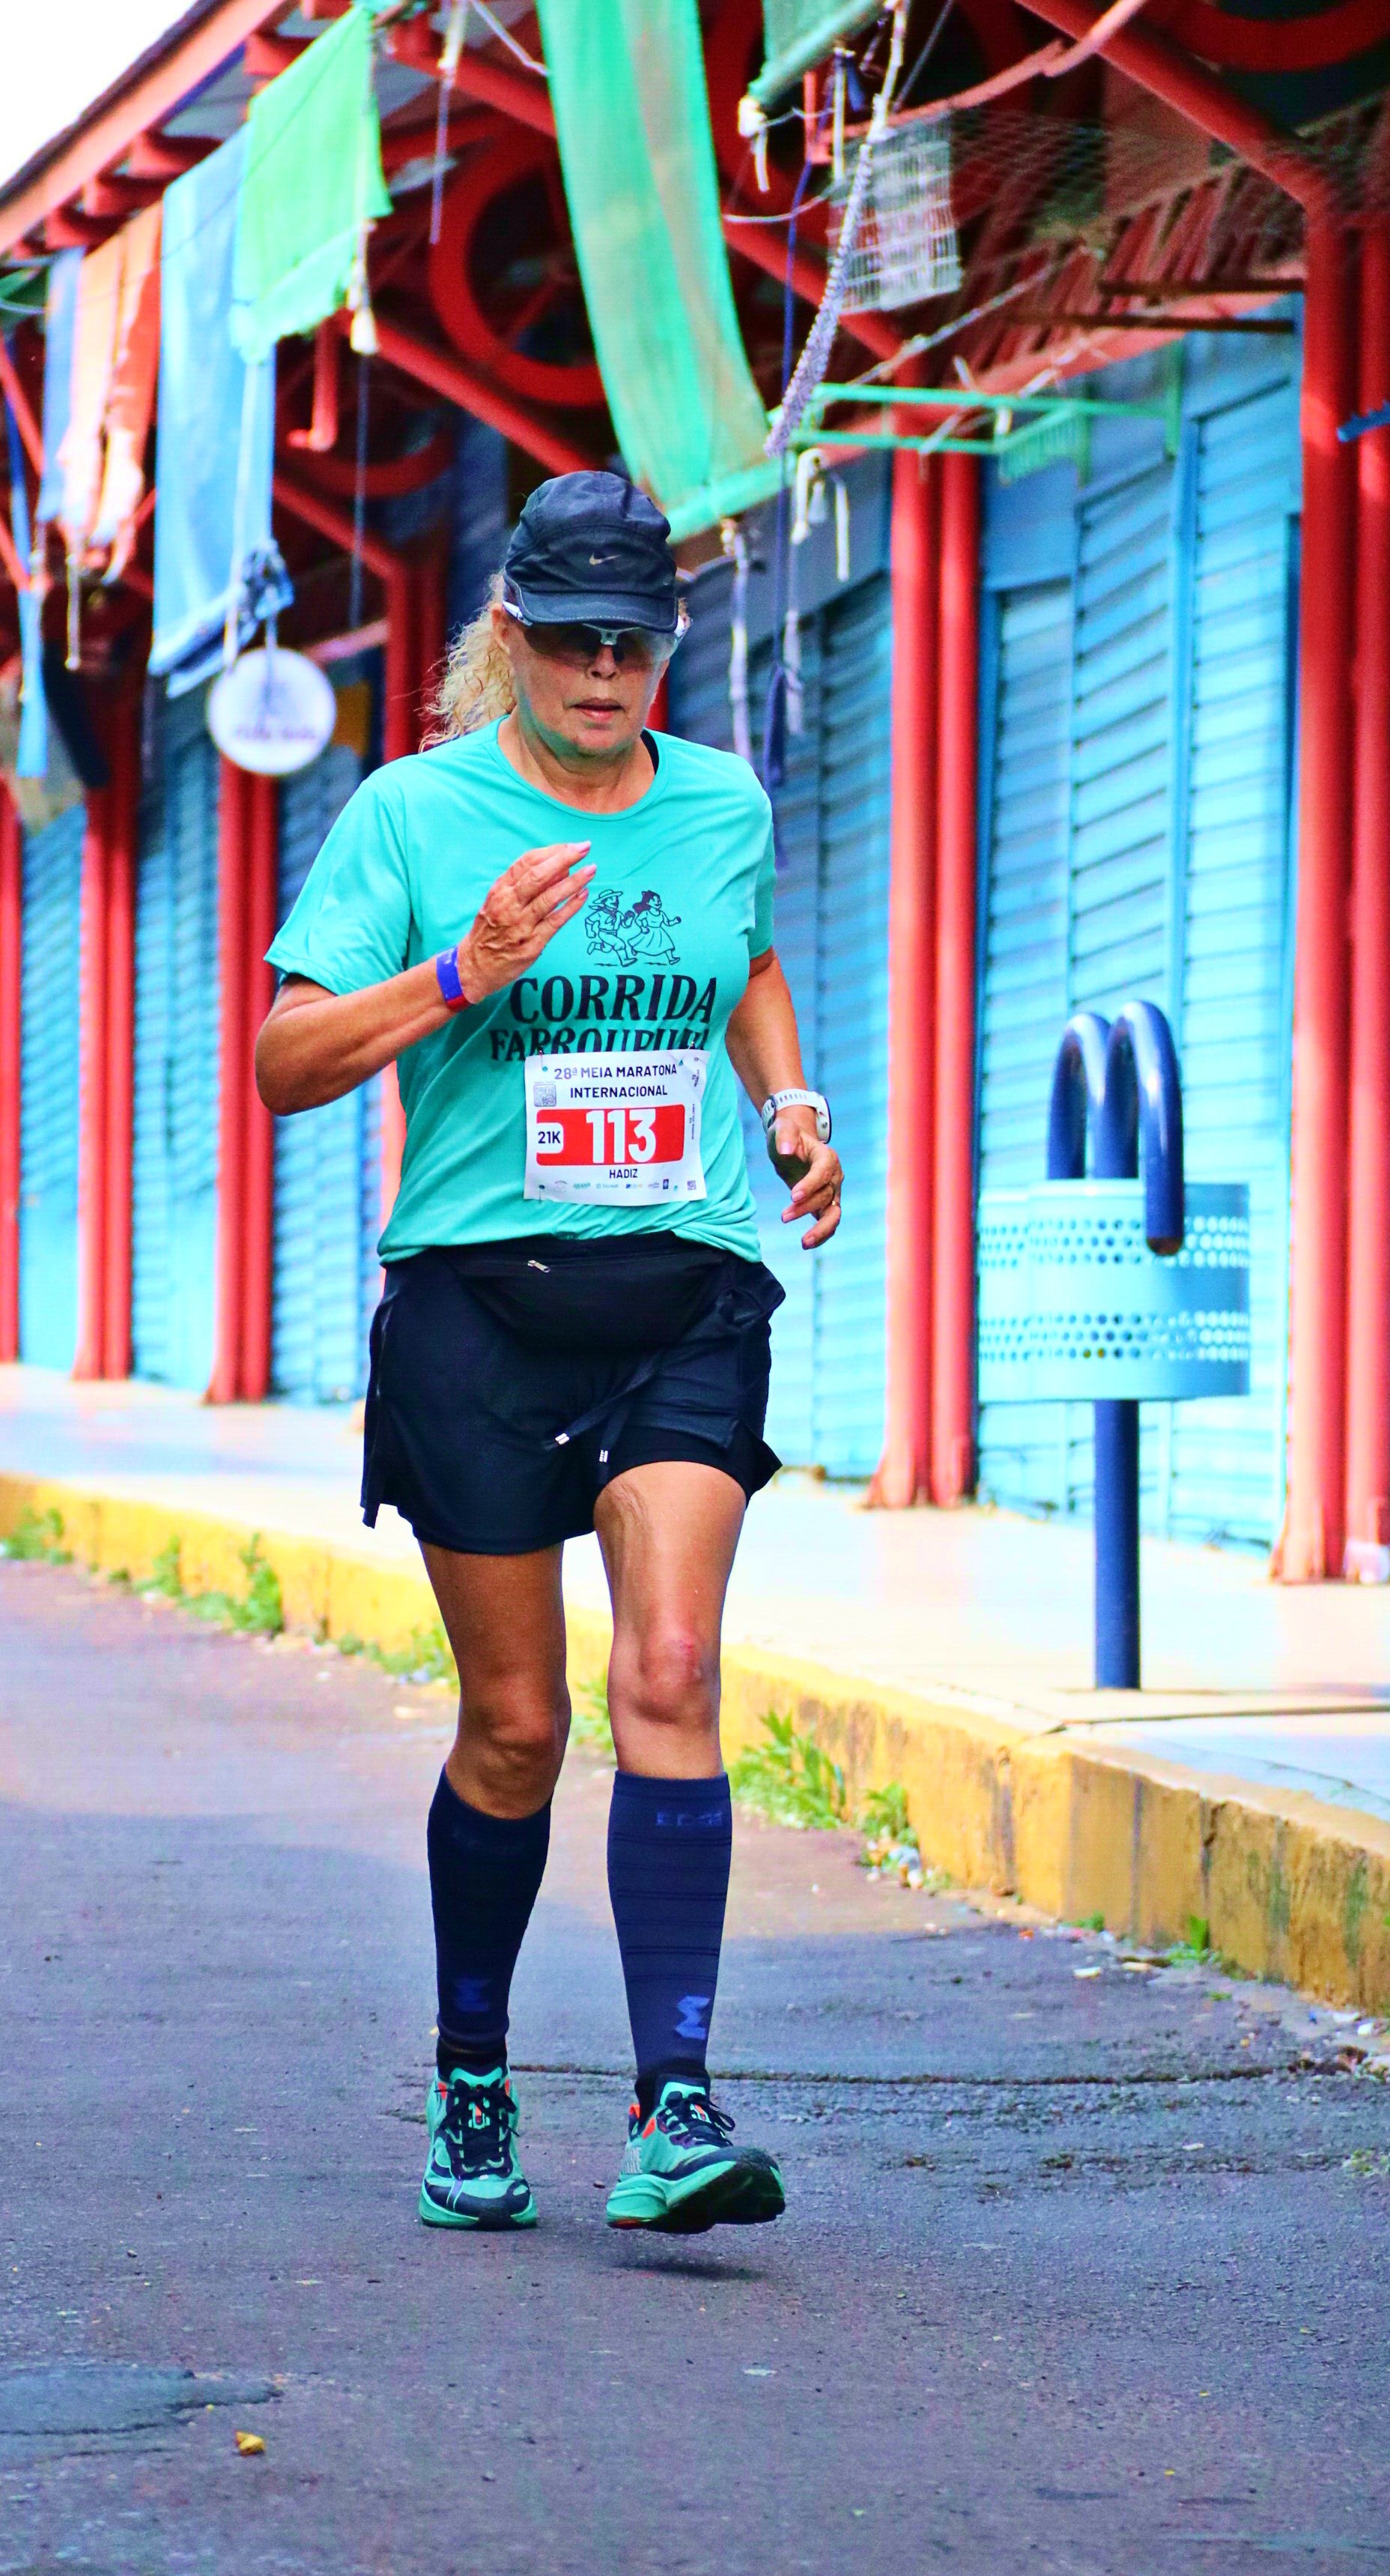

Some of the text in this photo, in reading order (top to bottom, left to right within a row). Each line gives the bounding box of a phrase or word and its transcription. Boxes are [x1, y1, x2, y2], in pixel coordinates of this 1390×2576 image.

[510, 974, 717, 1024] CORRIDA
[580, 1067, 613, 1078] MEIA
[616, 1063, 677, 1078] MARATONA
[570, 1085, 668, 1099] INTERNACIONAL
[538, 1131, 561, 1144] 21K
[586, 1108, 656, 1164] 113
[609, 1168, 638, 1179] HADIZ
